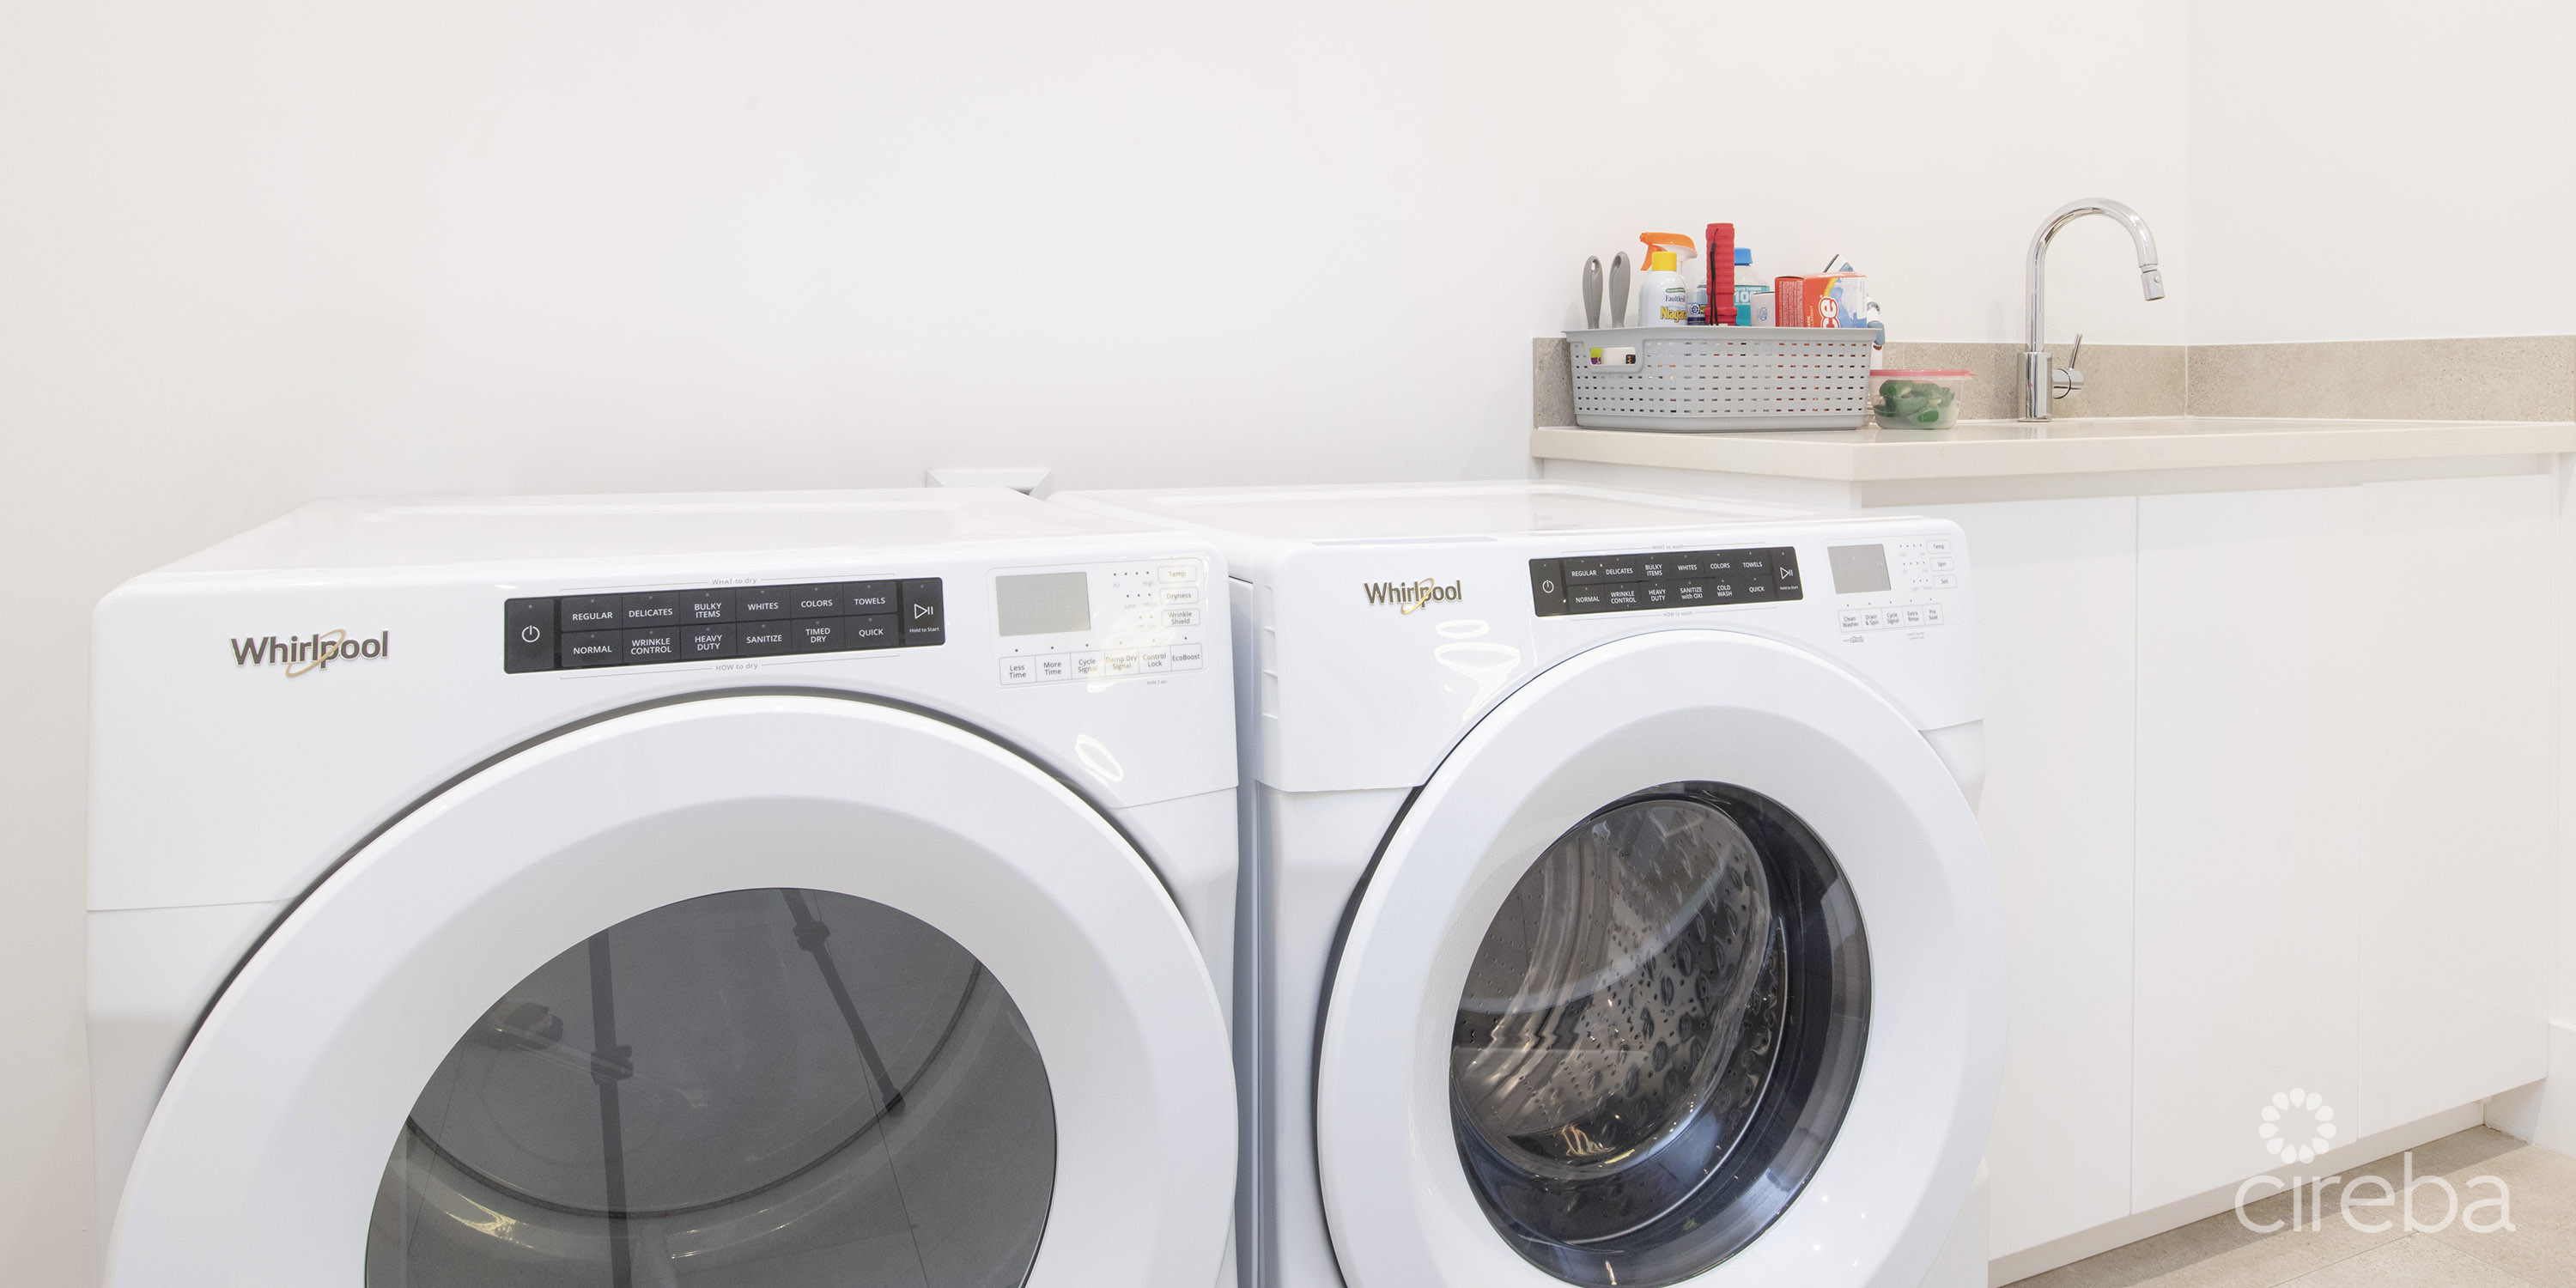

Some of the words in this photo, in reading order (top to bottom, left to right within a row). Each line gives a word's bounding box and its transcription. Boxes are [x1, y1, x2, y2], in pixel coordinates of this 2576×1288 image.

[1735, 291, 1752, 303] 10
[1166, 592, 1192, 601] Dryness
[1364, 580, 1462, 609] Whirlpool
[800, 599, 833, 609] COLORS
[854, 597, 886, 605] TOWELS
[694, 603, 722, 611] BULKY
[748, 602, 779, 611] WHITES
[572, 611, 613, 621] REGULAR
[629, 609, 673, 618] DELICATES
[805, 628, 830, 636] TIMED
[859, 628, 884, 637] QUICK
[631, 638, 671, 647] WRINKLE
[695, 635, 723, 643] HEAVY
[746, 635, 782, 644] SANITIZE
[230, 629, 389, 670] Whirlpool
[573, 646, 612, 654] NORMAL
[630, 646, 672, 654] CONTROL
[1105, 656, 1124, 665] Damp
[1126, 654, 1138, 663] Dry
[1142, 653, 1167, 661] Control
[1171, 653, 1200, 662] EcoBoost
[1078, 658, 1097, 666] Cycle
[1112, 662, 1132, 671] Signal
[1078, 665, 1098, 673] Signal
